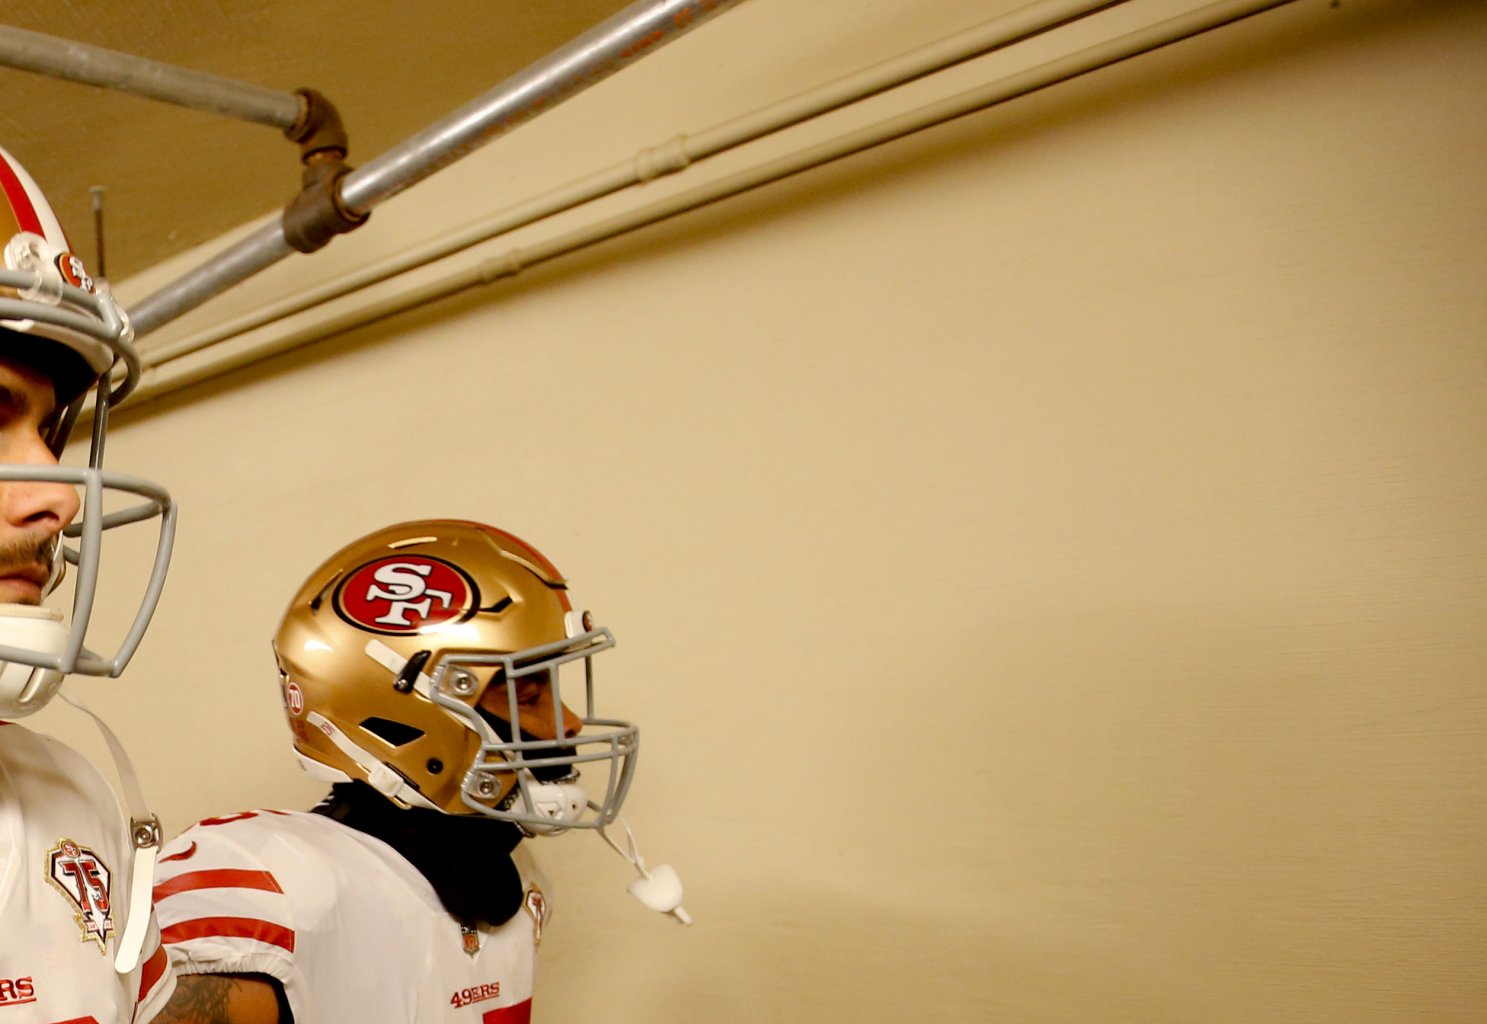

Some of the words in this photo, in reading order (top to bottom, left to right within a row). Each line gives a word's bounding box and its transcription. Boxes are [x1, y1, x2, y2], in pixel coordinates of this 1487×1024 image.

[366, 562, 453, 626] SF
[59, 859, 109, 916] 75
[450, 981, 500, 1008] 49ERS
